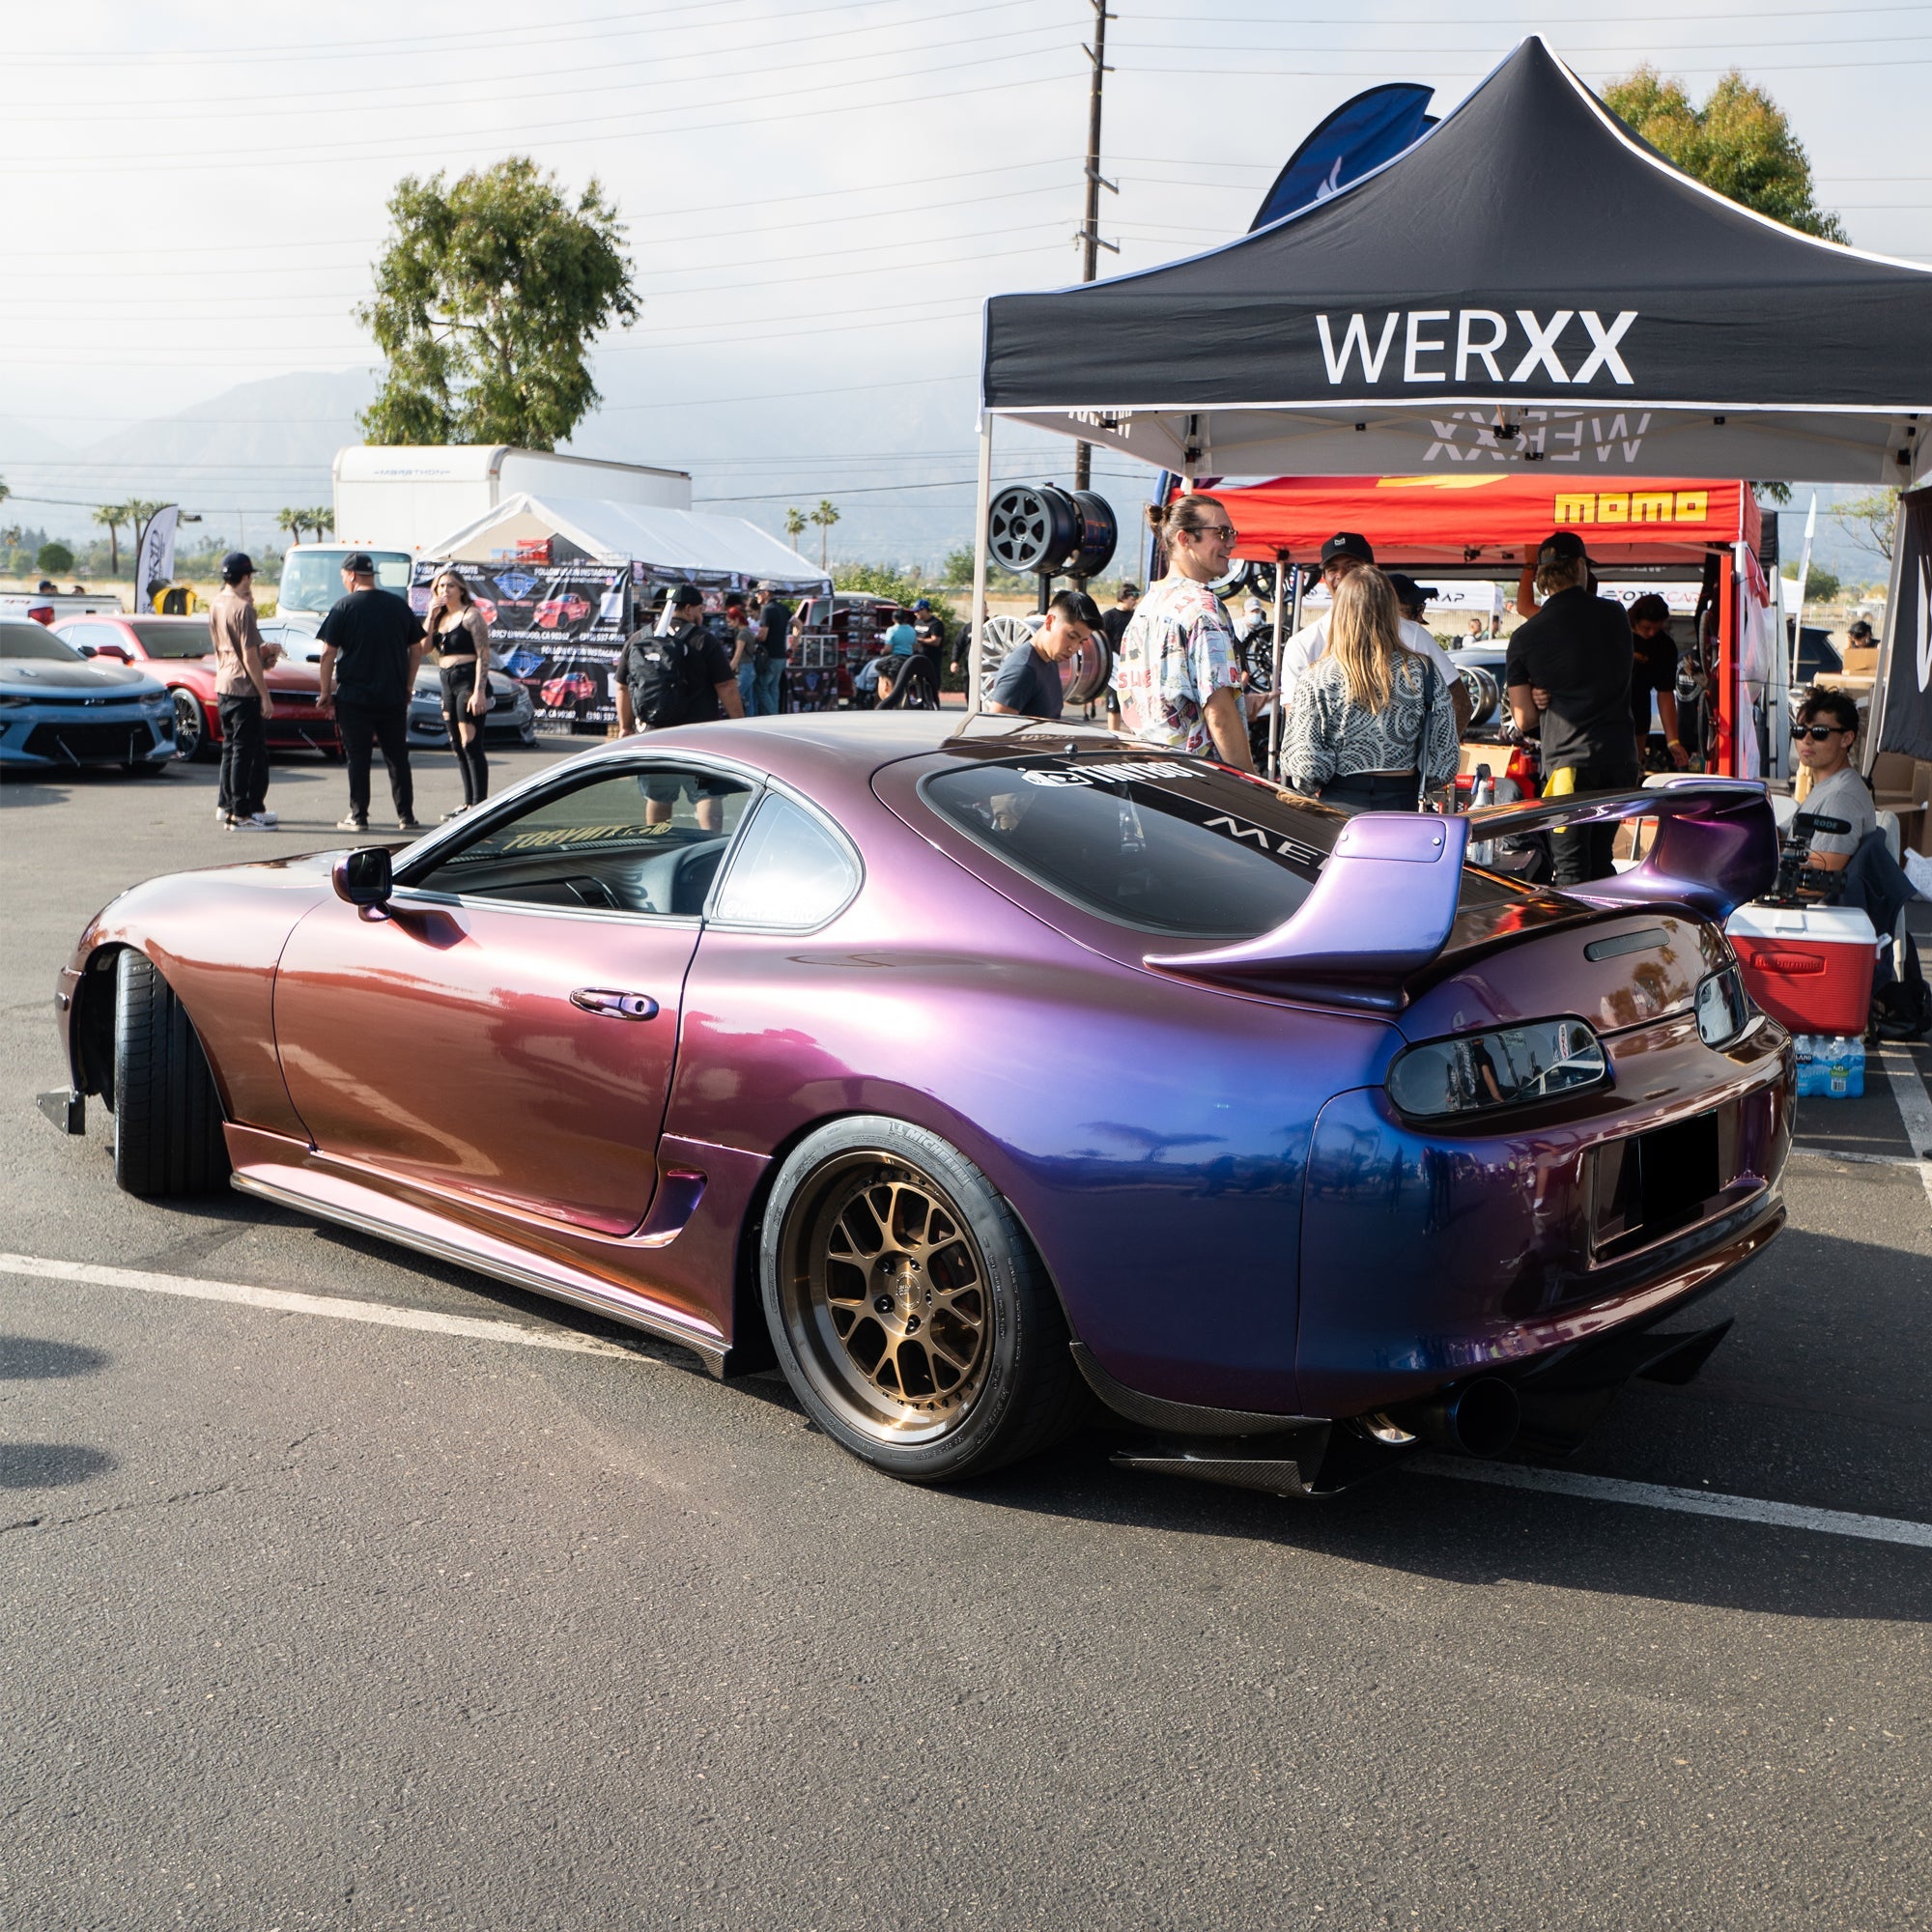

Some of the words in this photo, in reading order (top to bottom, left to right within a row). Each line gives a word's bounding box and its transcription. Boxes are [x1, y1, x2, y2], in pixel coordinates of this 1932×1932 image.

[1316, 309, 1639, 385] WERXX
[1065, 761, 1208, 784] TINYBOT
[1203, 815, 1329, 871] ME
[904, 1128, 971, 1187] MICHELIN
